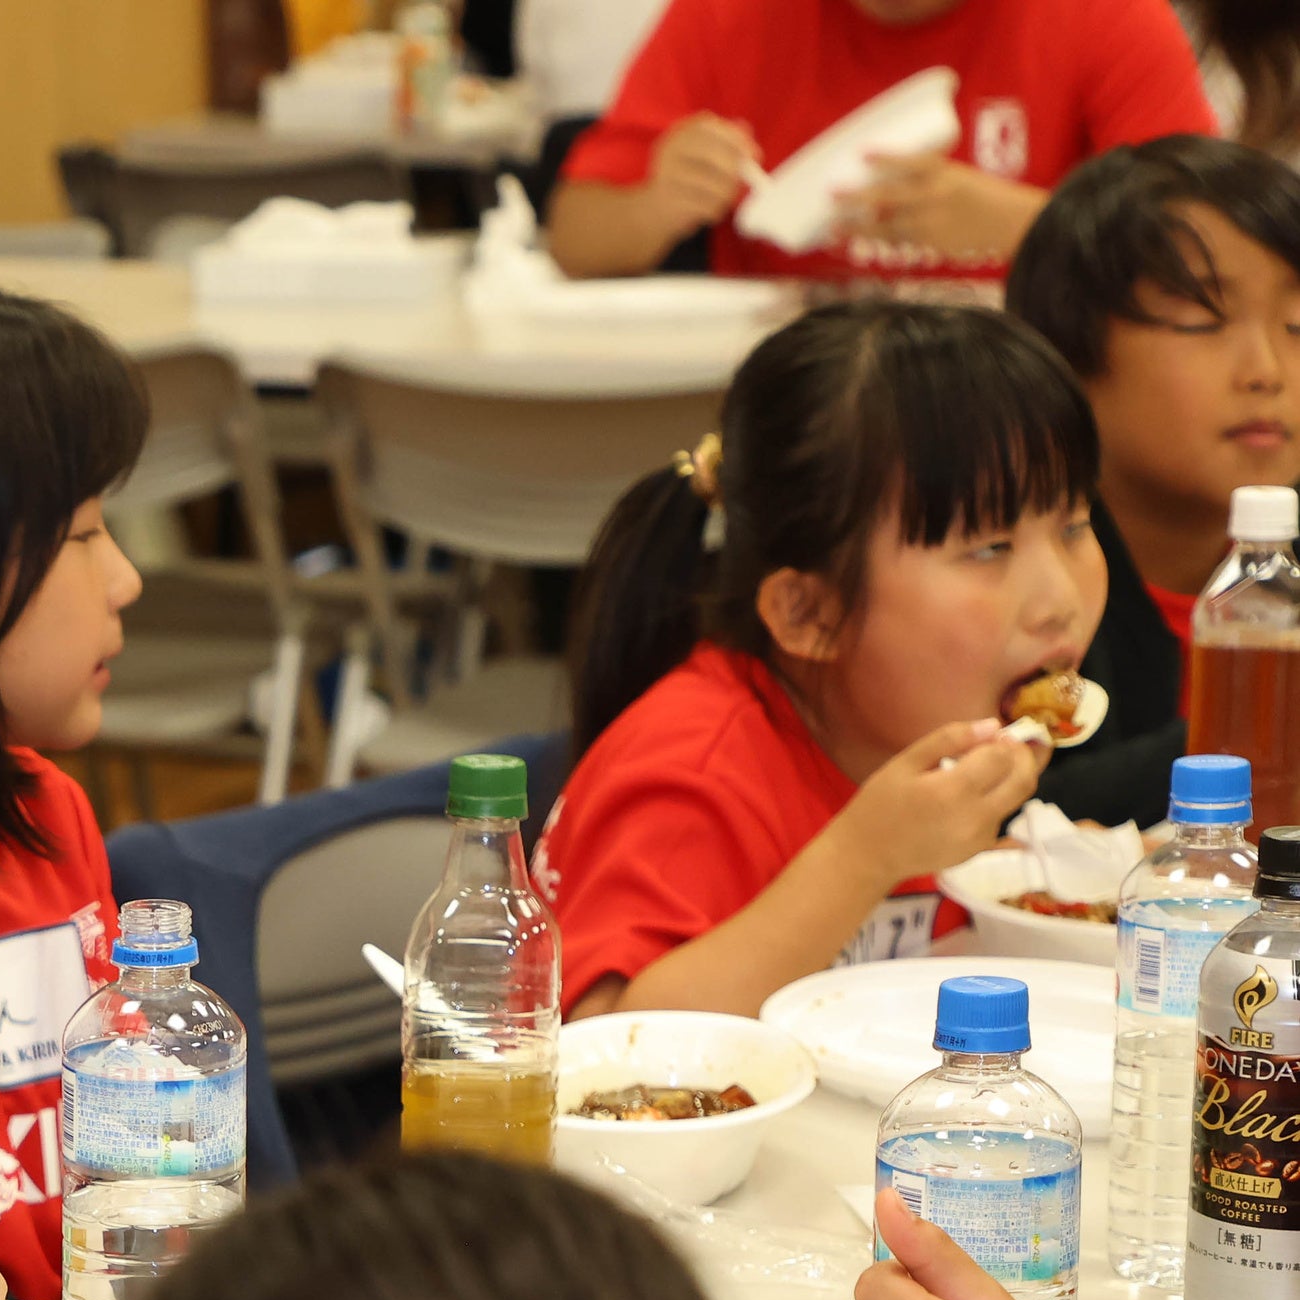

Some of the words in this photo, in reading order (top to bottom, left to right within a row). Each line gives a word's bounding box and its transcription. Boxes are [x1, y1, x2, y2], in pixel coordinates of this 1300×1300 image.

[1230, 1027, 1275, 1049] FIRE
[1204, 1047, 1300, 1083] ONEDA
[1194, 1073, 1300, 1142] Blac
[1215, 1172, 1275, 1195] 直火仕上げ
[1205, 1191, 1232, 1207] GOOD
[1234, 1199, 1288, 1214] ROASTED
[1220, 1207, 1261, 1223] COFFEE
